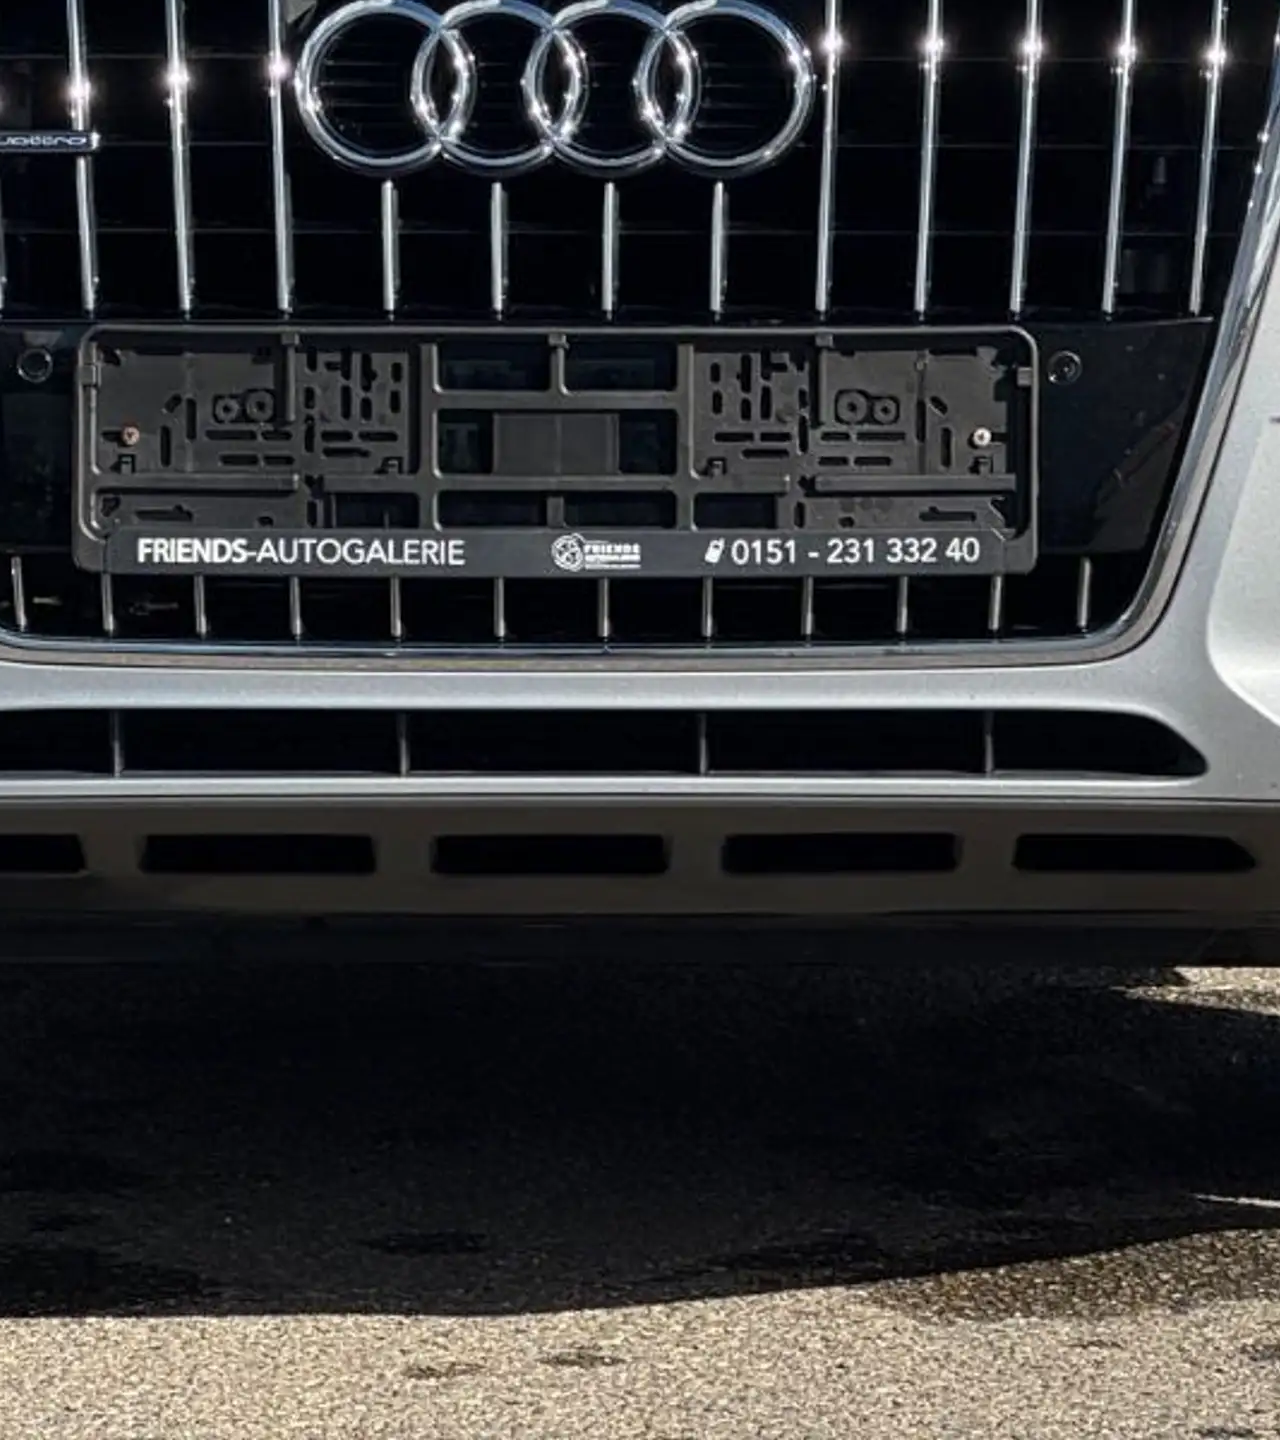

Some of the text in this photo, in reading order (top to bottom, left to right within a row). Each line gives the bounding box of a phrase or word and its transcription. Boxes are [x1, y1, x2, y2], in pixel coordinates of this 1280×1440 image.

[137, 537, 466, 565] FRIENDS-AUTOGALERIE
[731, 538, 796, 565] 0151
[826, 537, 874, 564] 231
[886, 537, 937, 564] 332
[945, 536, 981, 563] 40
